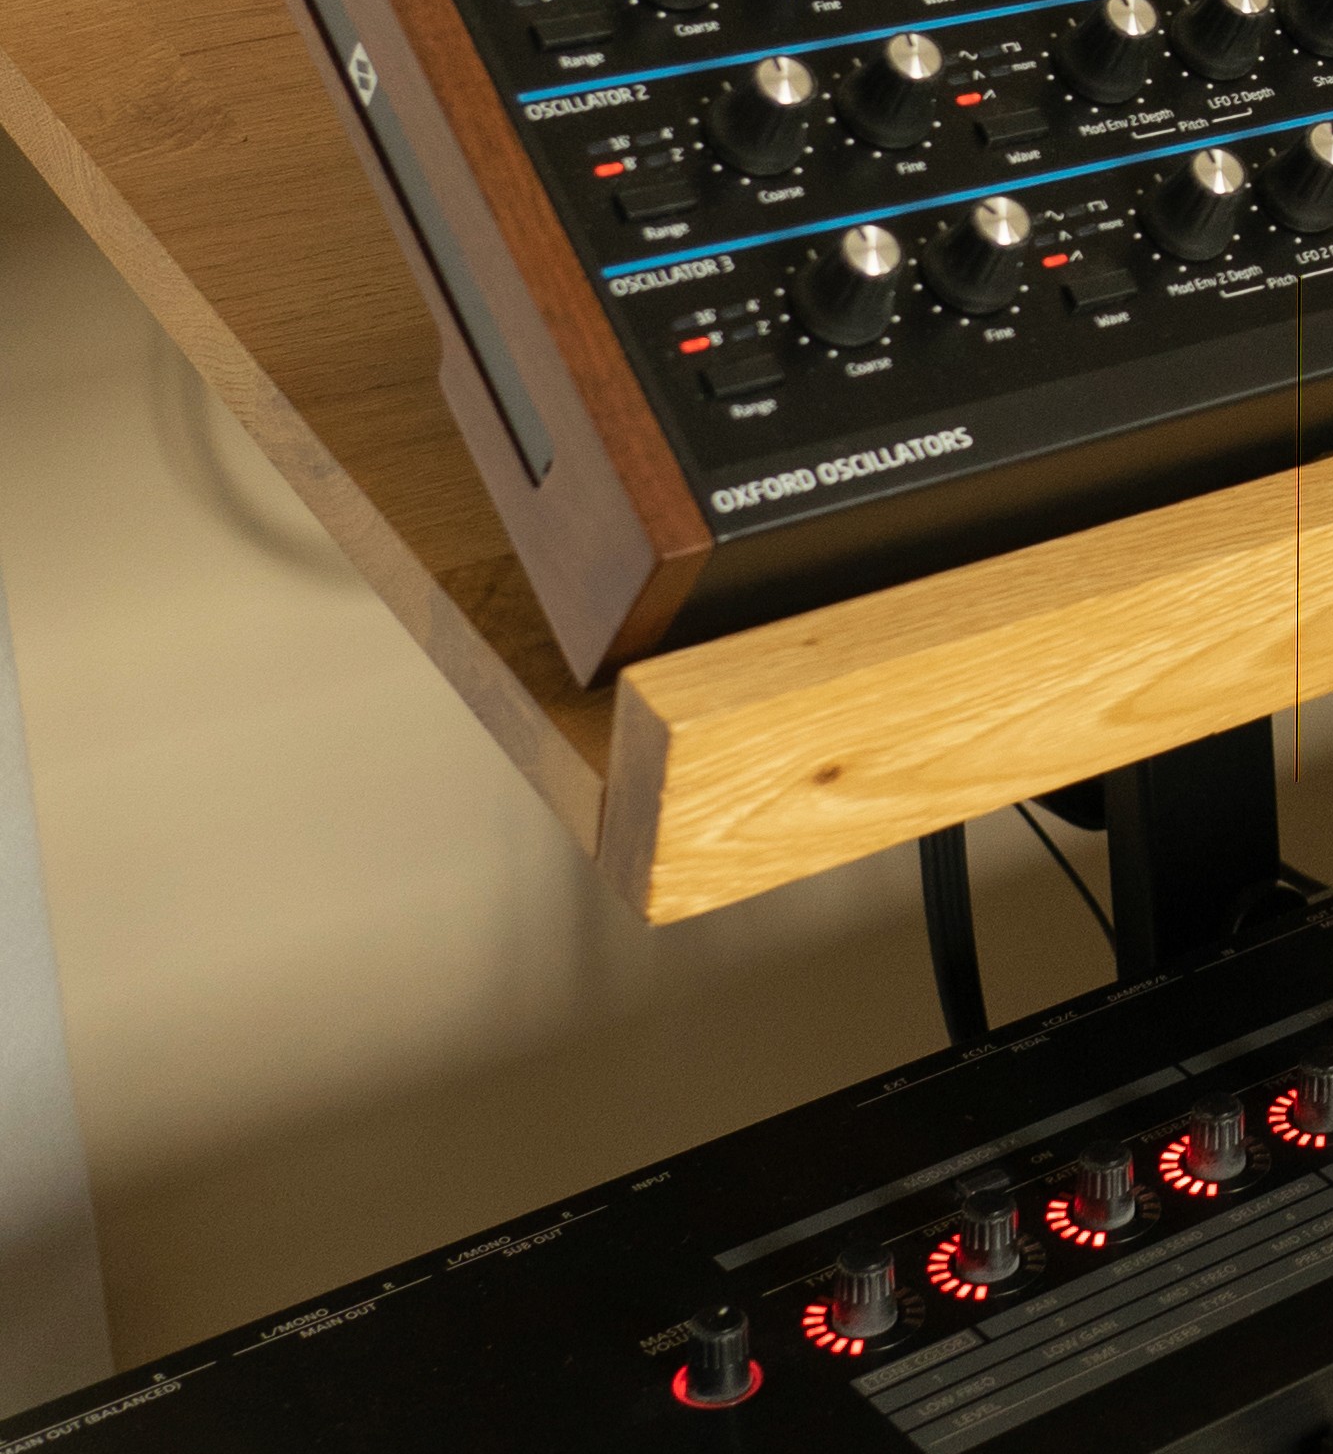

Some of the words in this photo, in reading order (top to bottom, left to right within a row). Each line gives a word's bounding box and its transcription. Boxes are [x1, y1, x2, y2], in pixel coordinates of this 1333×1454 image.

[674, 20, 720, 37] Coarse
[558, 52, 605, 69] Range
[524, 88, 634, 121] OSCILLATOR
[633, 84, 650, 101] 2
[609, 260, 718, 295] OSCILLATOR
[718, 255, 736, 273] 3
[711, 468, 817, 513] OXFORD
[815, 426, 974, 485] OSCILLATORS
